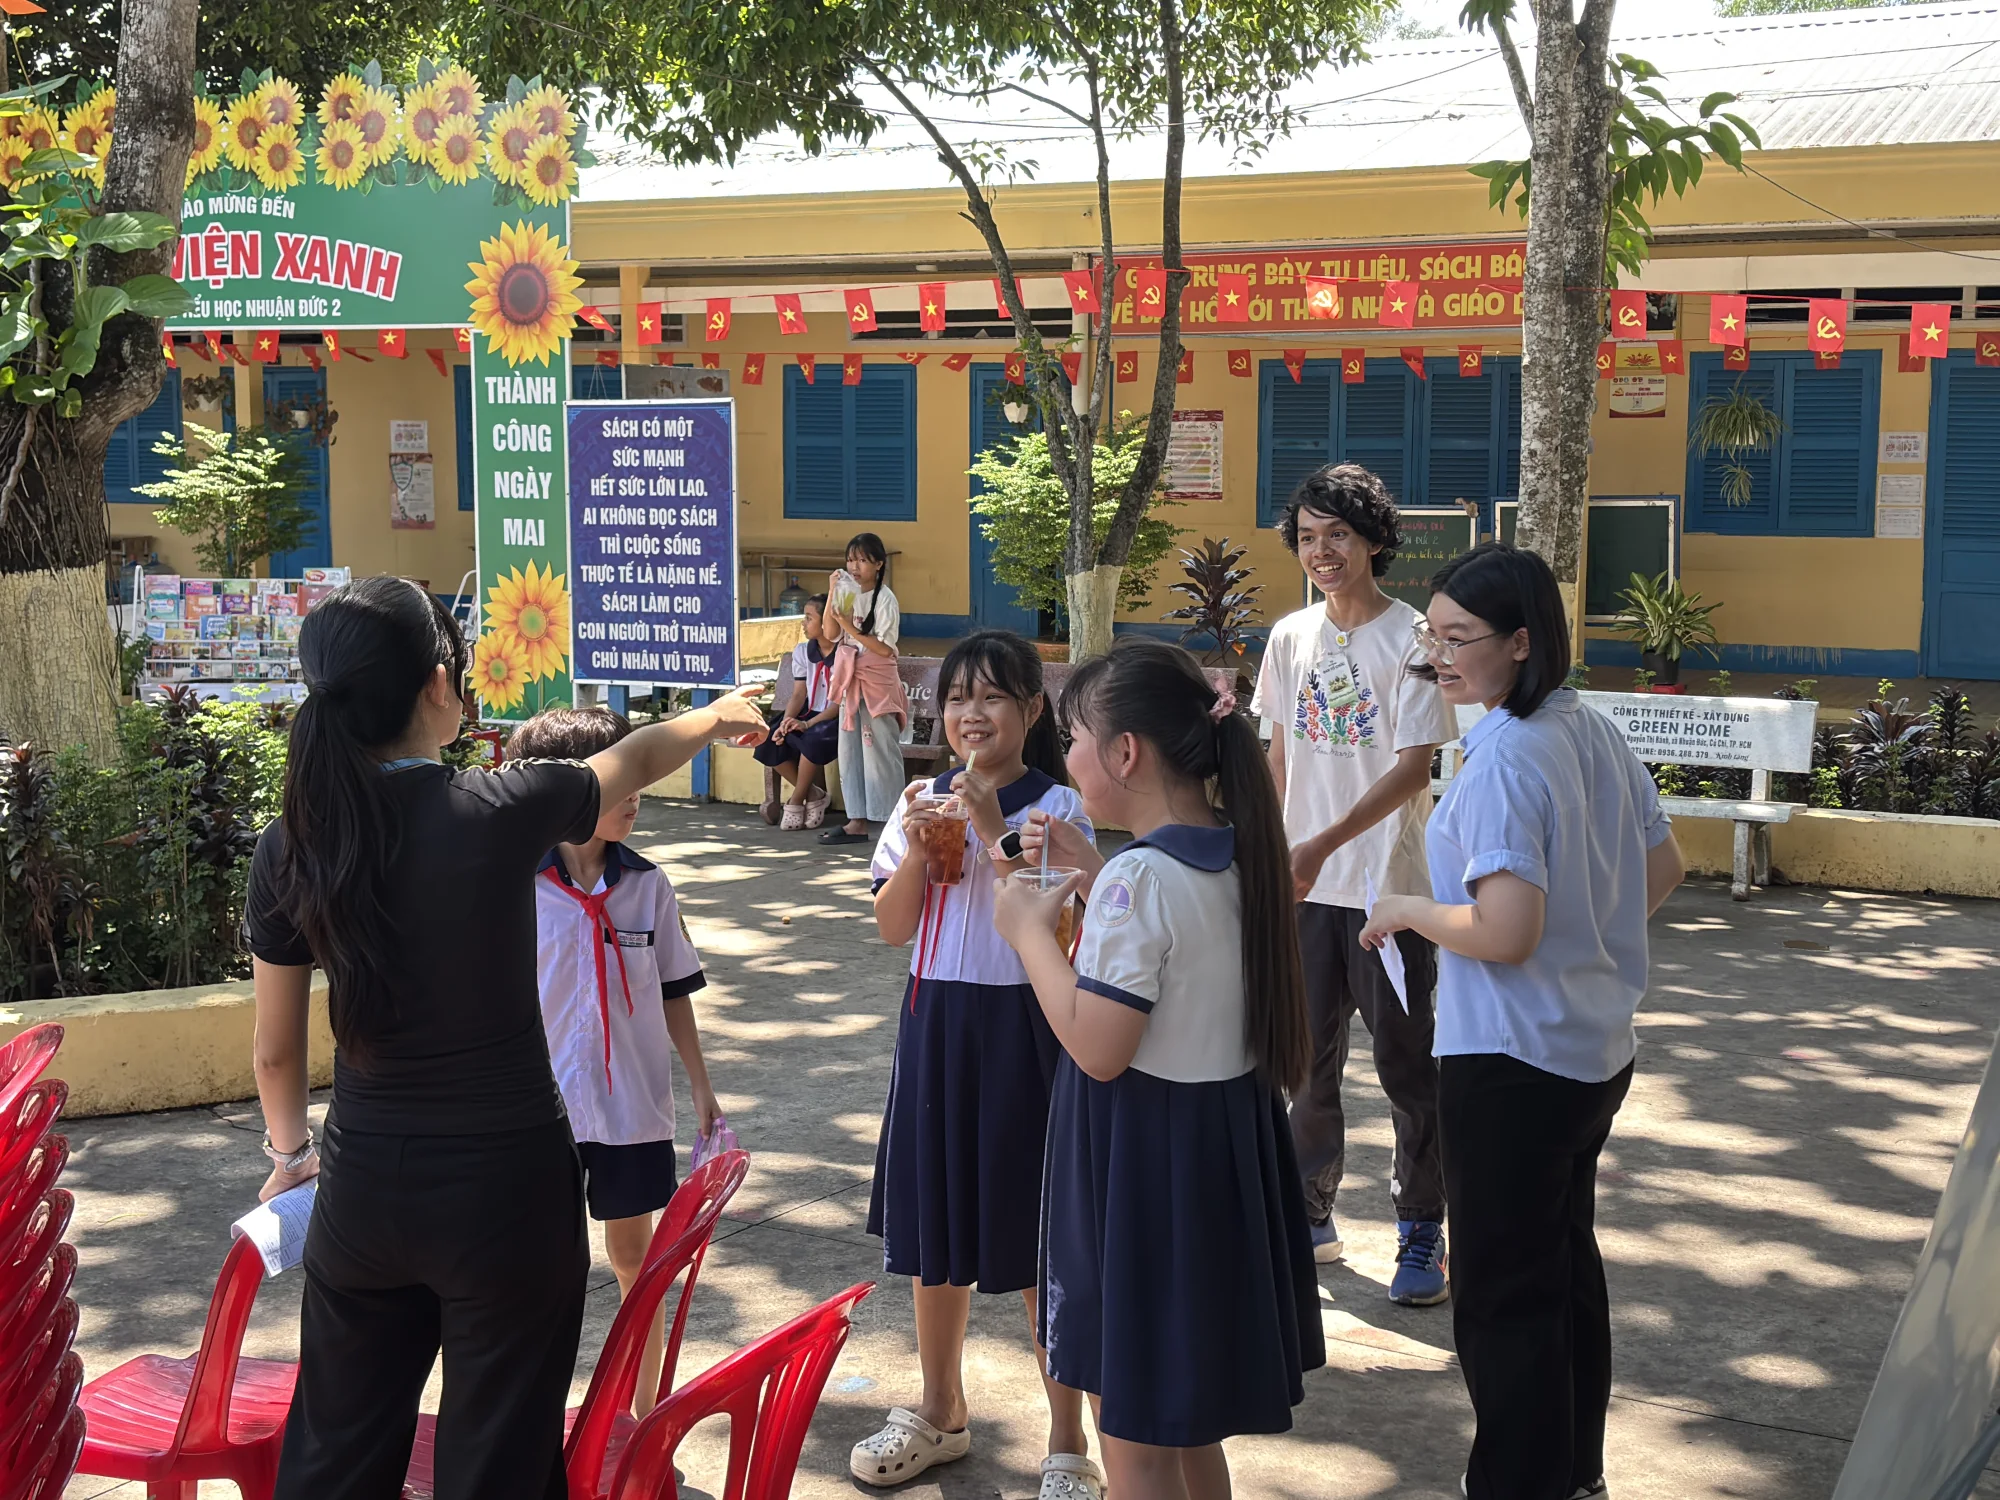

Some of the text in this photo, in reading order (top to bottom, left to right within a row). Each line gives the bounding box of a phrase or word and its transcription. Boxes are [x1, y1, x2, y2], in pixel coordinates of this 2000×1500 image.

[181, 194, 295, 222] ÀO MỪNG ĐẾN
[272, 231, 403, 302] XANH
[1265, 257, 1312, 285] BÀY
[1358, 253, 1411, 288] LIỆU,
[1420, 251, 1482, 280] SÁCH
[1490, 248, 1526, 278] BÁ
[214, 300, 242, 321] HỌC
[245, 296, 295, 321] NHUẬN
[298, 295, 328, 317] ĐỨC
[332, 299, 342, 317] 2
[1190, 292, 1219, 323] HỒ
[1247, 294, 1273, 322] ỚI
[1352, 295, 1384, 319] NH
[1413, 288, 1435, 317] À
[1443, 287, 1505, 317] GIÁO
[485, 371, 556, 404] THÀNH
[493, 418, 552, 452] CÔNG
[602, 416, 694, 441] SÁCH CÓ MỘT
[613, 446, 685, 471] SỨC MẠNH
[494, 466, 552, 499] NGÀY
[591, 473, 708, 497] HẾT SỨC LỚN LAO.
[583, 504, 717, 530] AI KHÔNG ĐỌC SÁCH
[503, 518, 545, 546] MAI
[599, 532, 701, 558] THÌ CUỘC SỐNG
[581, 564, 615, 586] THỰC
[618, 561, 634, 583] TẾ
[637, 563, 654, 583] LÀ
[657, 563, 696, 588] NẶNG
[602, 591, 701, 614] SÁCH LÀM CHO
[578, 619, 727, 644] CON NGƯỜI TRỞ THÀNH
[592, 646, 714, 676] CHỦ NHÂN VŨ TRỤ.
[1612, 705, 1638, 717] CÔNG
[1641, 708, 1652, 718] TY
[1654, 706, 1681, 719] THIẾT
[1683, 707, 1696, 720] KẾ
[1703, 710, 1722, 721] XÂY
[1723, 712, 1750, 724] DỰNG
[1628, 719, 1731, 738] GREEN HOME
[1631, 746, 1657, 756] TLINE:
